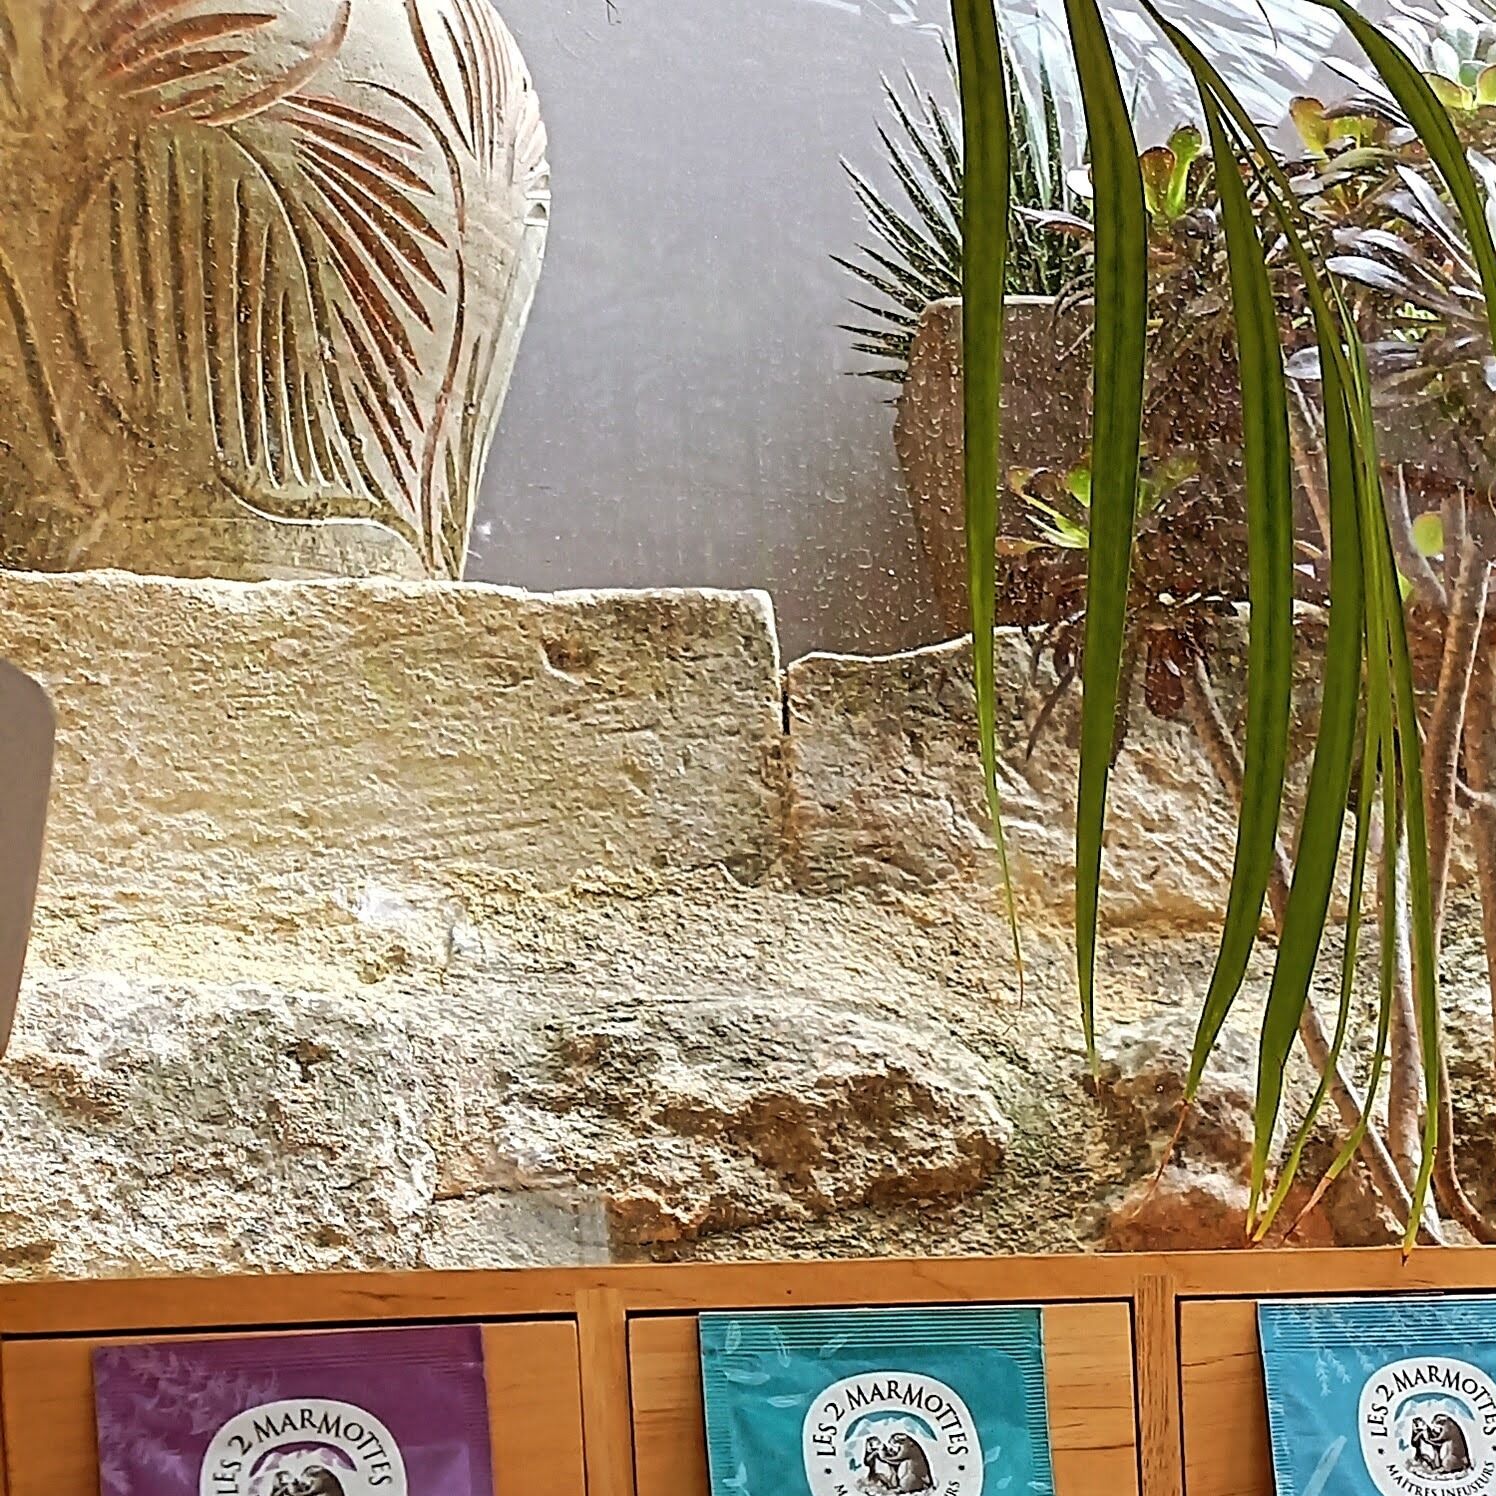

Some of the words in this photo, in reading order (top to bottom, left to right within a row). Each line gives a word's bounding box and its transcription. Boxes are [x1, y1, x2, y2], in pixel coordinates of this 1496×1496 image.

[1376, 1385, 1394, 1402] 2
[824, 1403, 845, 1421] 2
[846, 1380, 968, 1455] MARMOTTES
[1367, 1403, 1389, 1436] LES
[213, 1459, 242, 1495] LES
[228, 1436, 252, 1456] 2
[253, 1408, 393, 1486] MARMOTTES
[813, 1423, 838, 1456] LES
